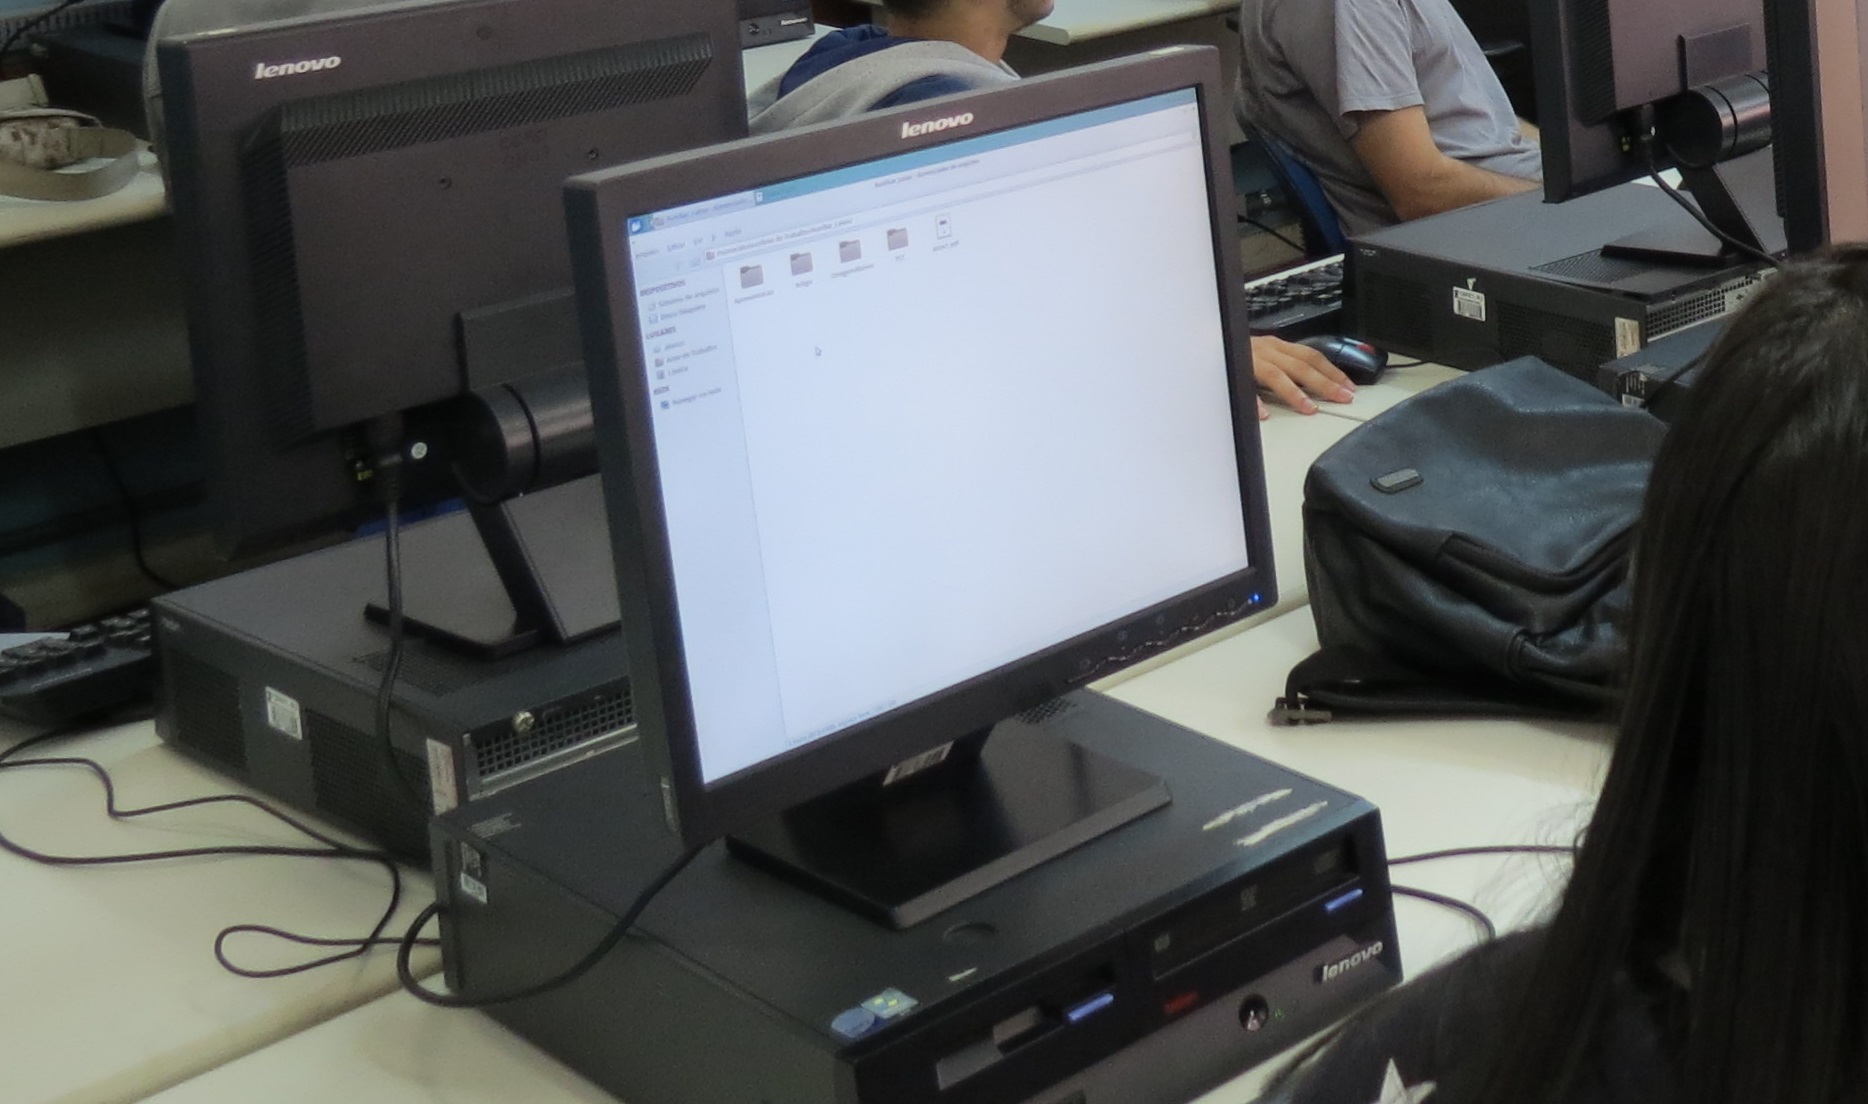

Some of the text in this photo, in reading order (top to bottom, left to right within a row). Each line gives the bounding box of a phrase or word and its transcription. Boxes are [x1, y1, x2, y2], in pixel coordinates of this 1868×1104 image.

[253, 53, 342, 81] lenovo
[900, 109, 976, 139] lenovo
[1318, 940, 1384, 984] lenovo
